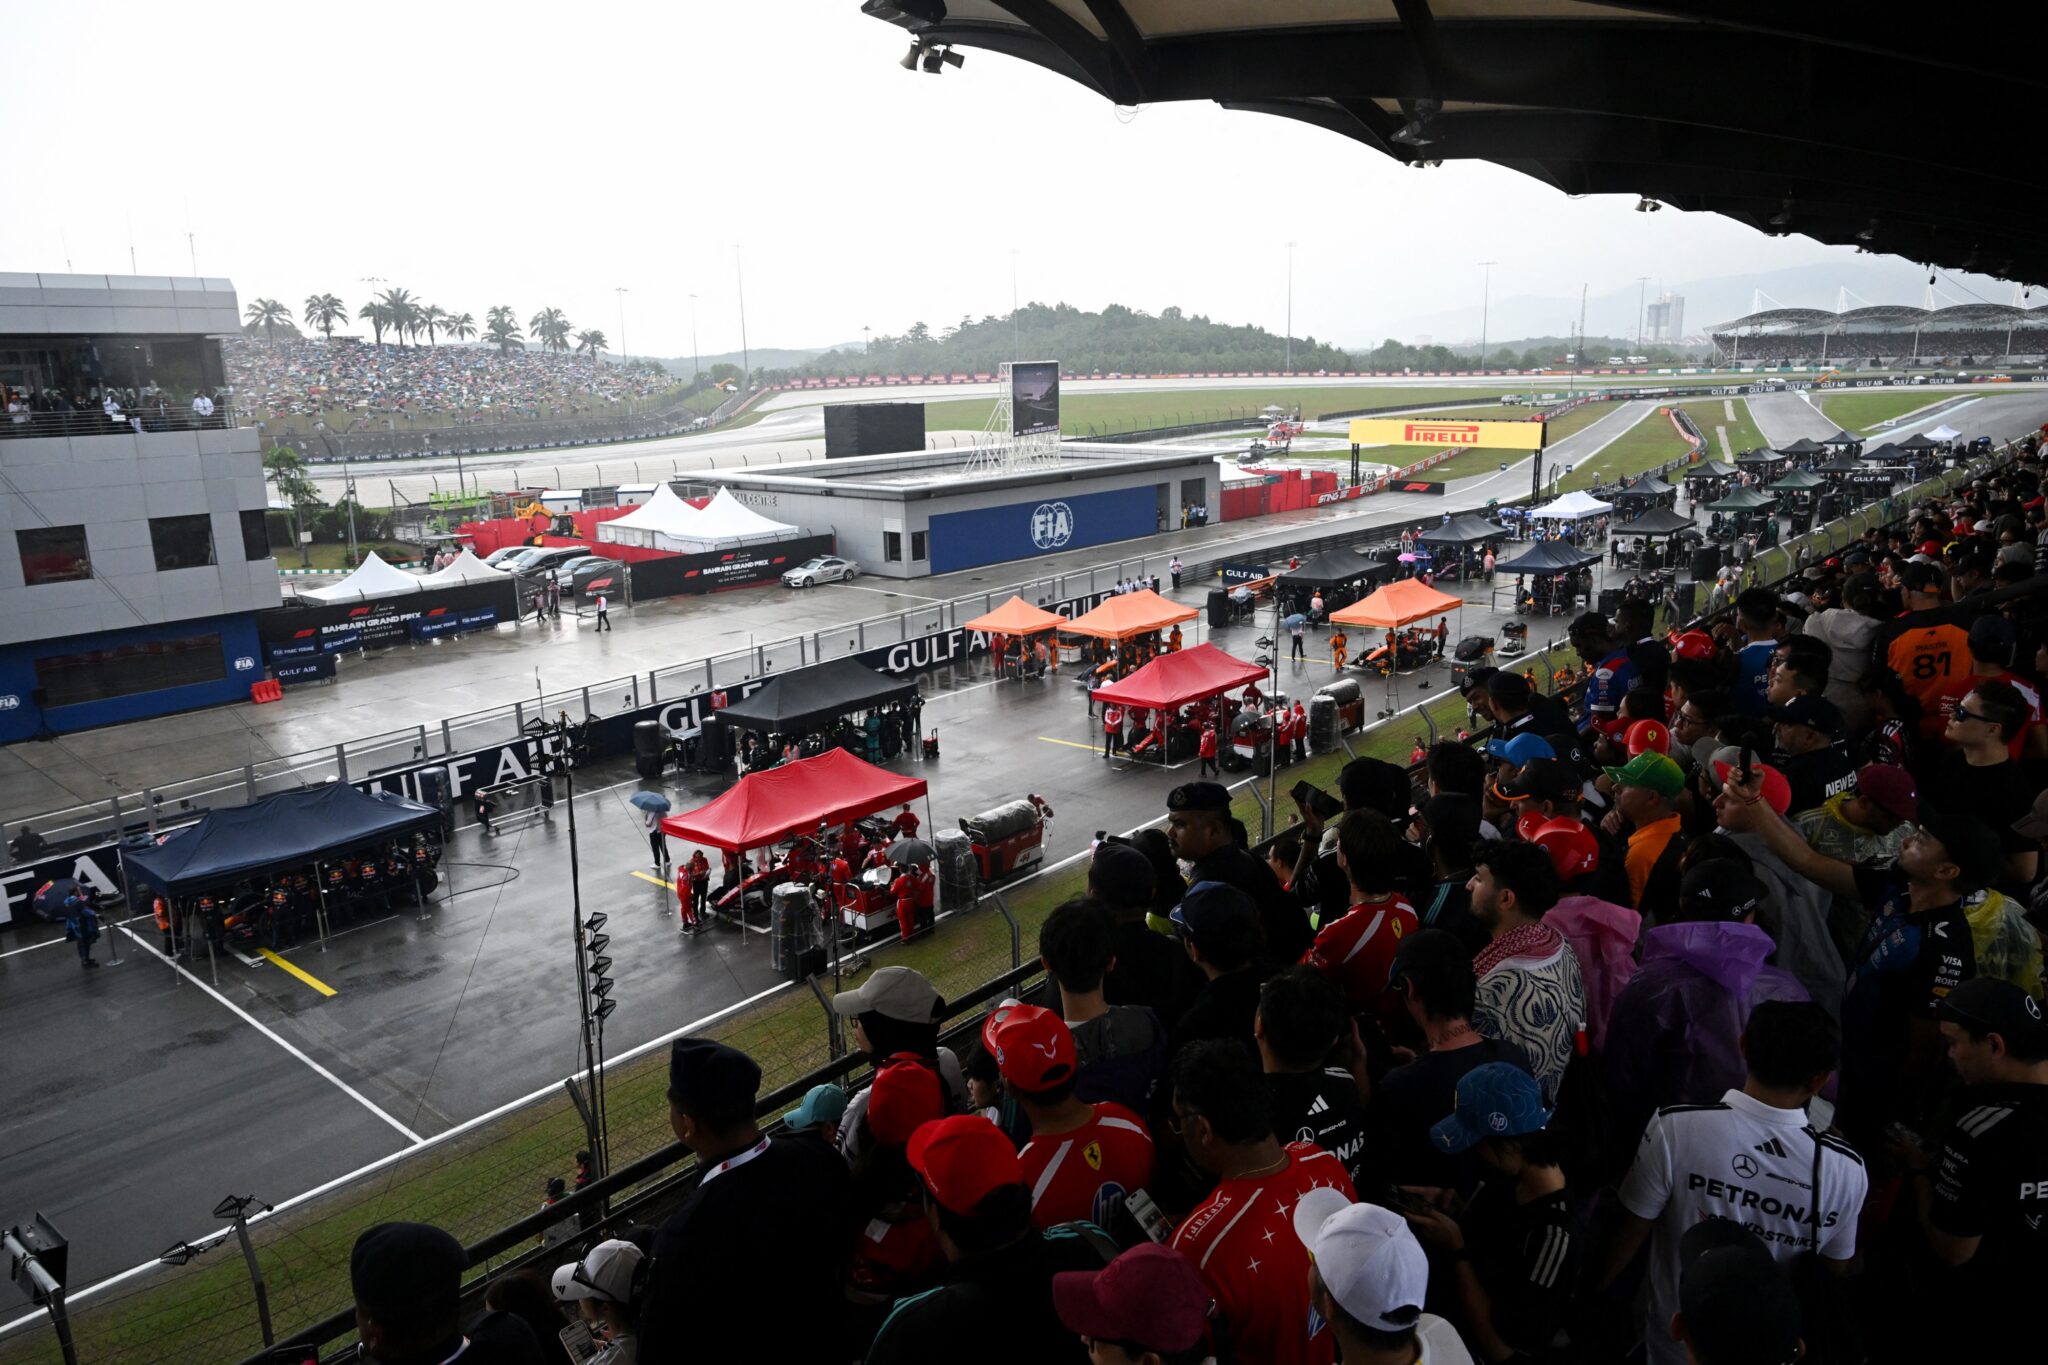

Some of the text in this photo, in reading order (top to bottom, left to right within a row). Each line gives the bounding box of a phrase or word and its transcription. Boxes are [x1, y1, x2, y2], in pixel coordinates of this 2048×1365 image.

[1404, 424, 1480, 443] PIRELLI
[1034, 512, 1069, 540] FIA
[703, 566, 732, 575] BAHRAIN
[1226, 570, 1248, 578] GULF
[322, 612, 422, 634] BAHRAIN GRAND PRIX
[888, 630, 963, 673] GULF
[235, 659, 253, 669] FIA
[1913, 652, 1951, 680] 81
[1941, 954, 1962, 968] VISA
[1934, 976, 1959, 986] ROKT
[1490, 1114, 1506, 1129] hp
[1689, 1173, 1839, 1228] PETRONAS
